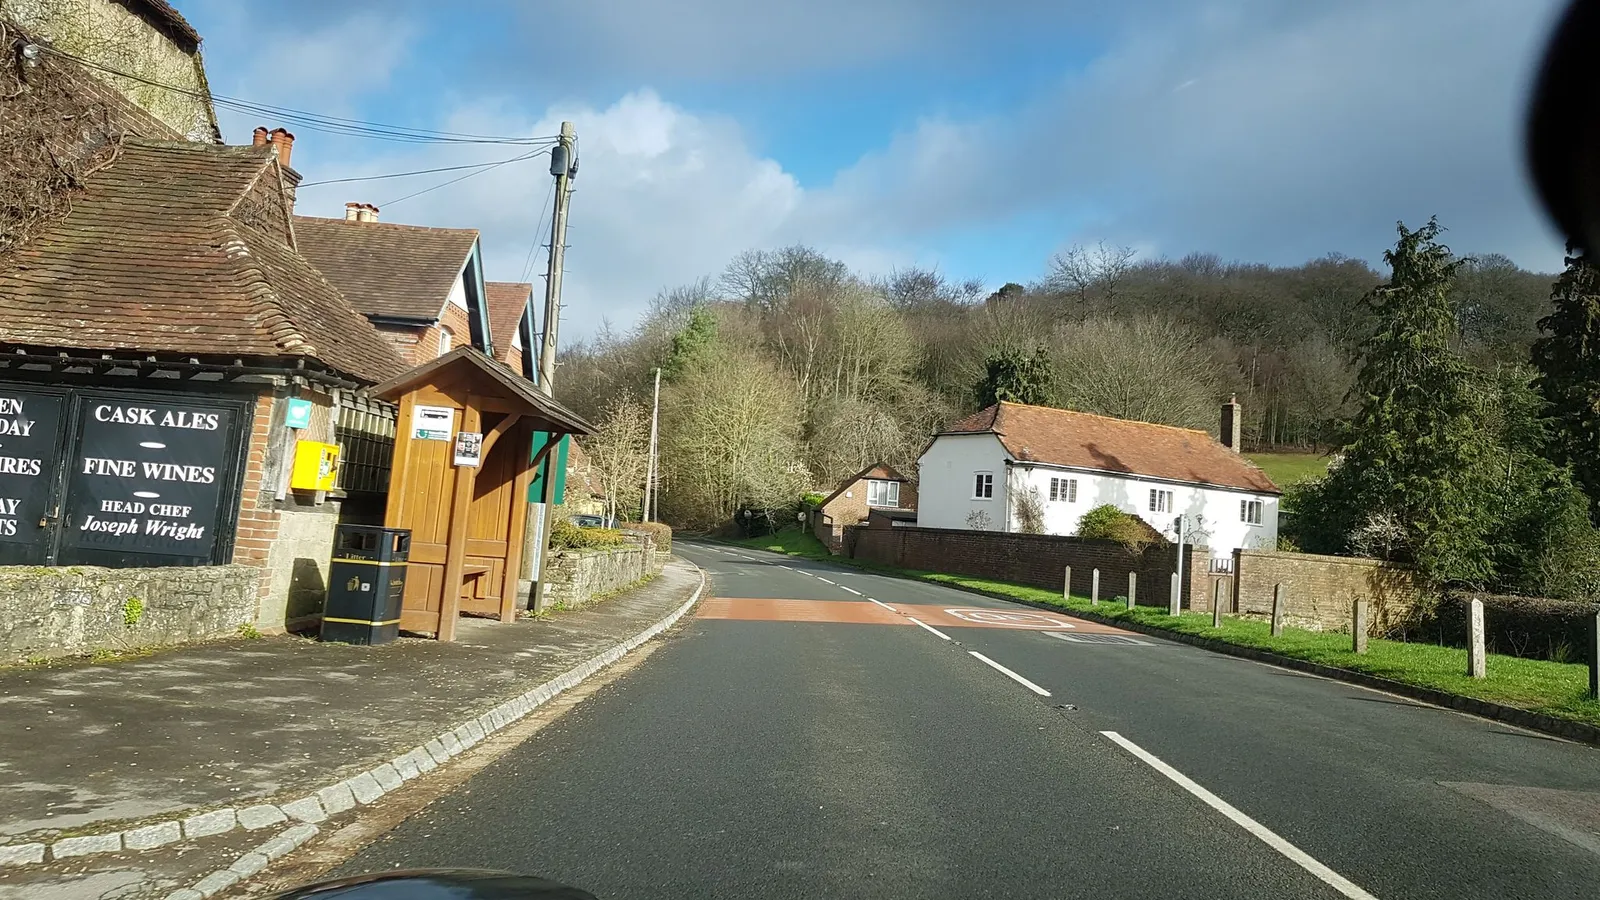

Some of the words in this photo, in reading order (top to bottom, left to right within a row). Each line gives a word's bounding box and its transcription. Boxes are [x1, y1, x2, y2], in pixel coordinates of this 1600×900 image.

[95, 405, 156, 425] CASK
[160, 411, 219, 430] ALES
[82, 458, 136, 478] FINE
[142, 462, 215, 484] WINES
[100, 500, 146, 514] HEAD
[149, 504, 192, 518] CHEF
[80, 515, 139, 536] Joseph
[145, 519, 205, 541] Wright
[345, 552, 367, 560] Litter
